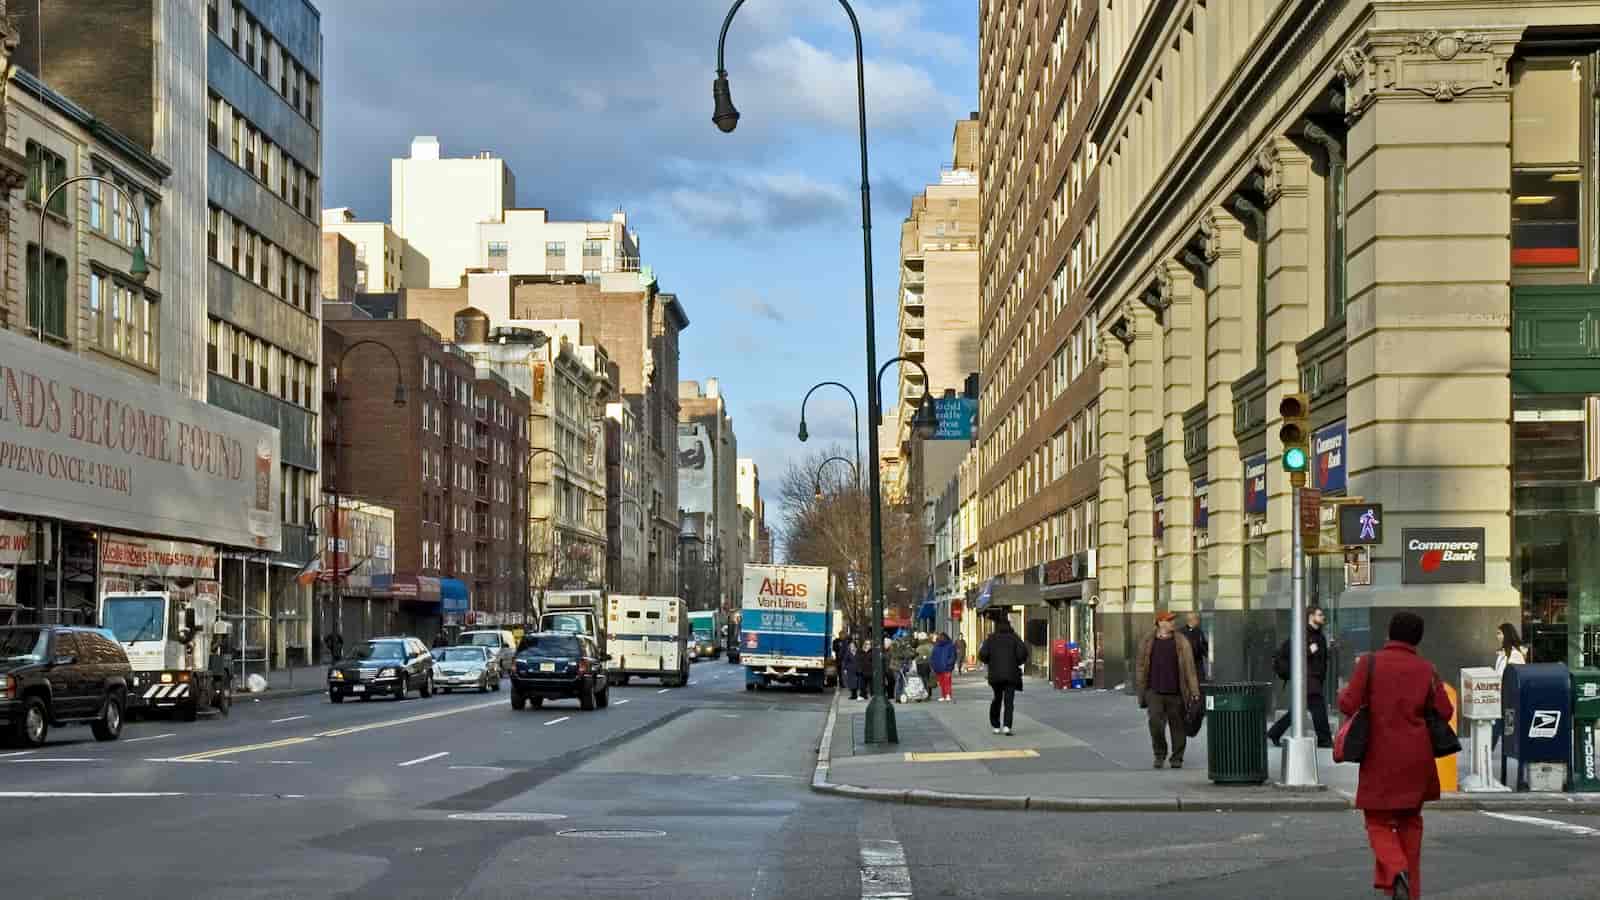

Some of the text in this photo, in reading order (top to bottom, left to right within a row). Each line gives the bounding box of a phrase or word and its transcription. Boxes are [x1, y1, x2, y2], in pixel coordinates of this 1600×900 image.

[0, 366, 242, 480] NDS BECOME FOUND
[1316, 434, 1342, 456] Commerce
[48, 452, 87, 483] ONCE
[1328, 449, 1341, 469] Bank
[1408, 539, 1479, 551] Commerce
[1442, 550, 1476, 561] Bank
[759, 576, 808, 597] Atlas
[757, 596, 808, 609] Van Lines
[1584, 732, 1594, 779] JOBS
